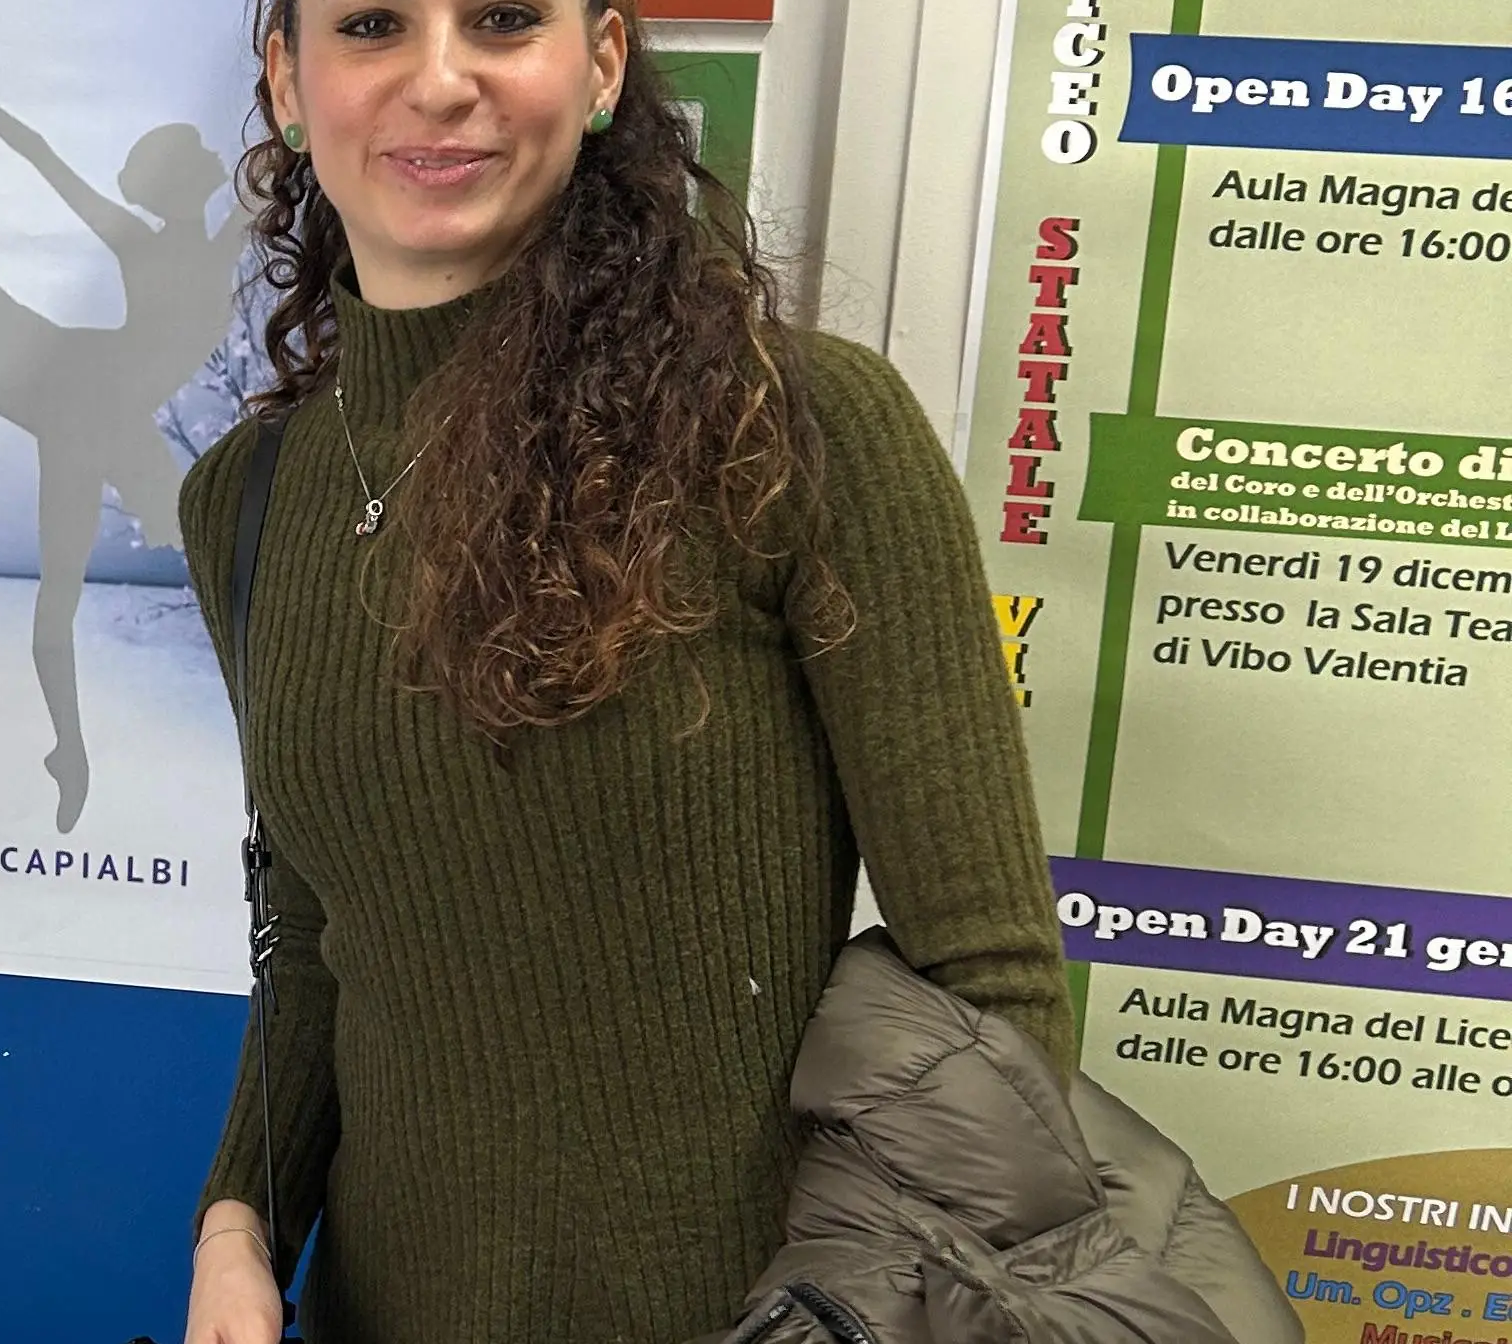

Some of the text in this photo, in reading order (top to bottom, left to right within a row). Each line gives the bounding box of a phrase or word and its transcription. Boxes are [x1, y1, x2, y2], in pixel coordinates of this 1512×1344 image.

[1150, 65, 1310, 113] Open
[1324, 71, 1444, 123] Day
[1212, 169, 1460, 216] Aula Magna
[1208, 219, 1511, 263] dalle ore 16:00
[1175, 426, 1444, 478] Concerto
[1170, 472, 1218, 493] del
[1225, 475, 1296, 499] Coro
[1302, 484, 1320, 498] e
[1167, 501, 1489, 540] in collaborazione del
[1166, 541, 1512, 594] Venerdì 19 dicem
[1156, 592, 1512, 642] presso la Sala Tea
[1153, 636, 1468, 687] di Vibo Valentia
[1056, 892, 1408, 961] Open Day 21
[1119, 986, 1512, 1050] Aula Magna del Lice
[1115, 1033, 1481, 1094] dalle ore 16:00 alle
[1287, 1184, 1299, 1210] I
[1309, 1186, 1458, 1228] NOSTRI
[1303, 1228, 1512, 1278] Linguistico
[1286, 1270, 1454, 1320] Um. Opz
